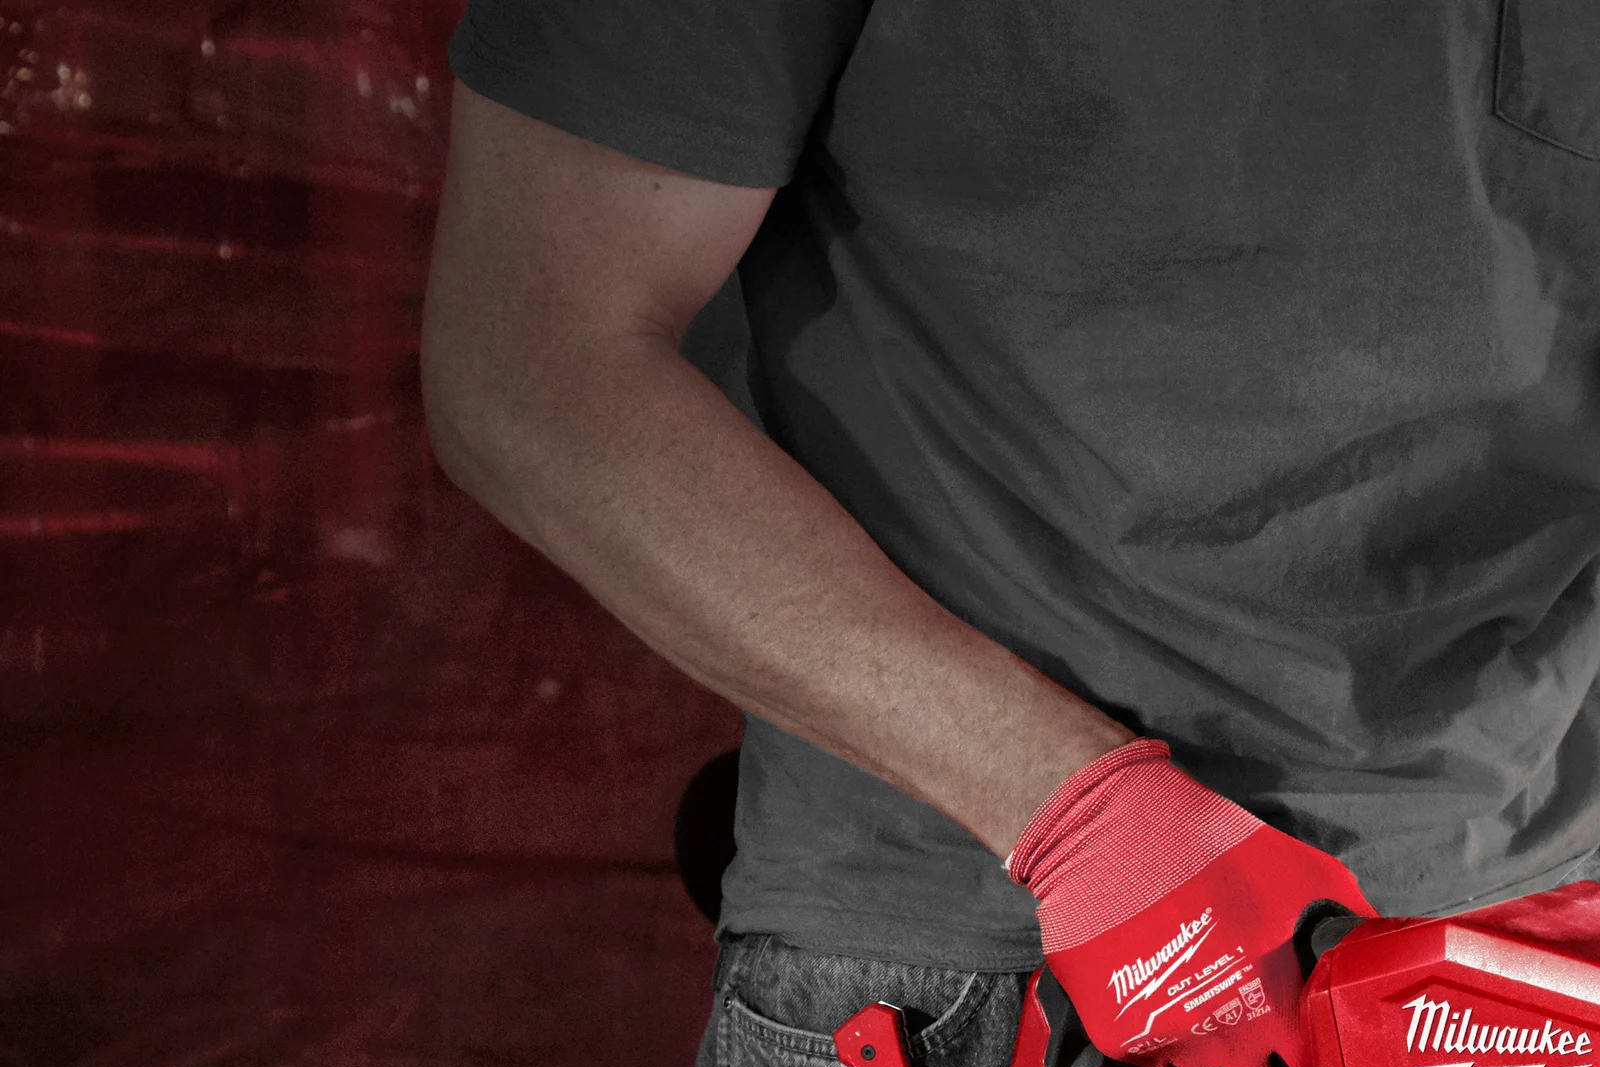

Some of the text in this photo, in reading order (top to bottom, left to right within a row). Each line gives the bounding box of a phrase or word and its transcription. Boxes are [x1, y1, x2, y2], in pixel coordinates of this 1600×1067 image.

[1167, 946, 1244, 997] CUT LEVEL 1
[1401, 994, 1593, 1055] Milwaukee
